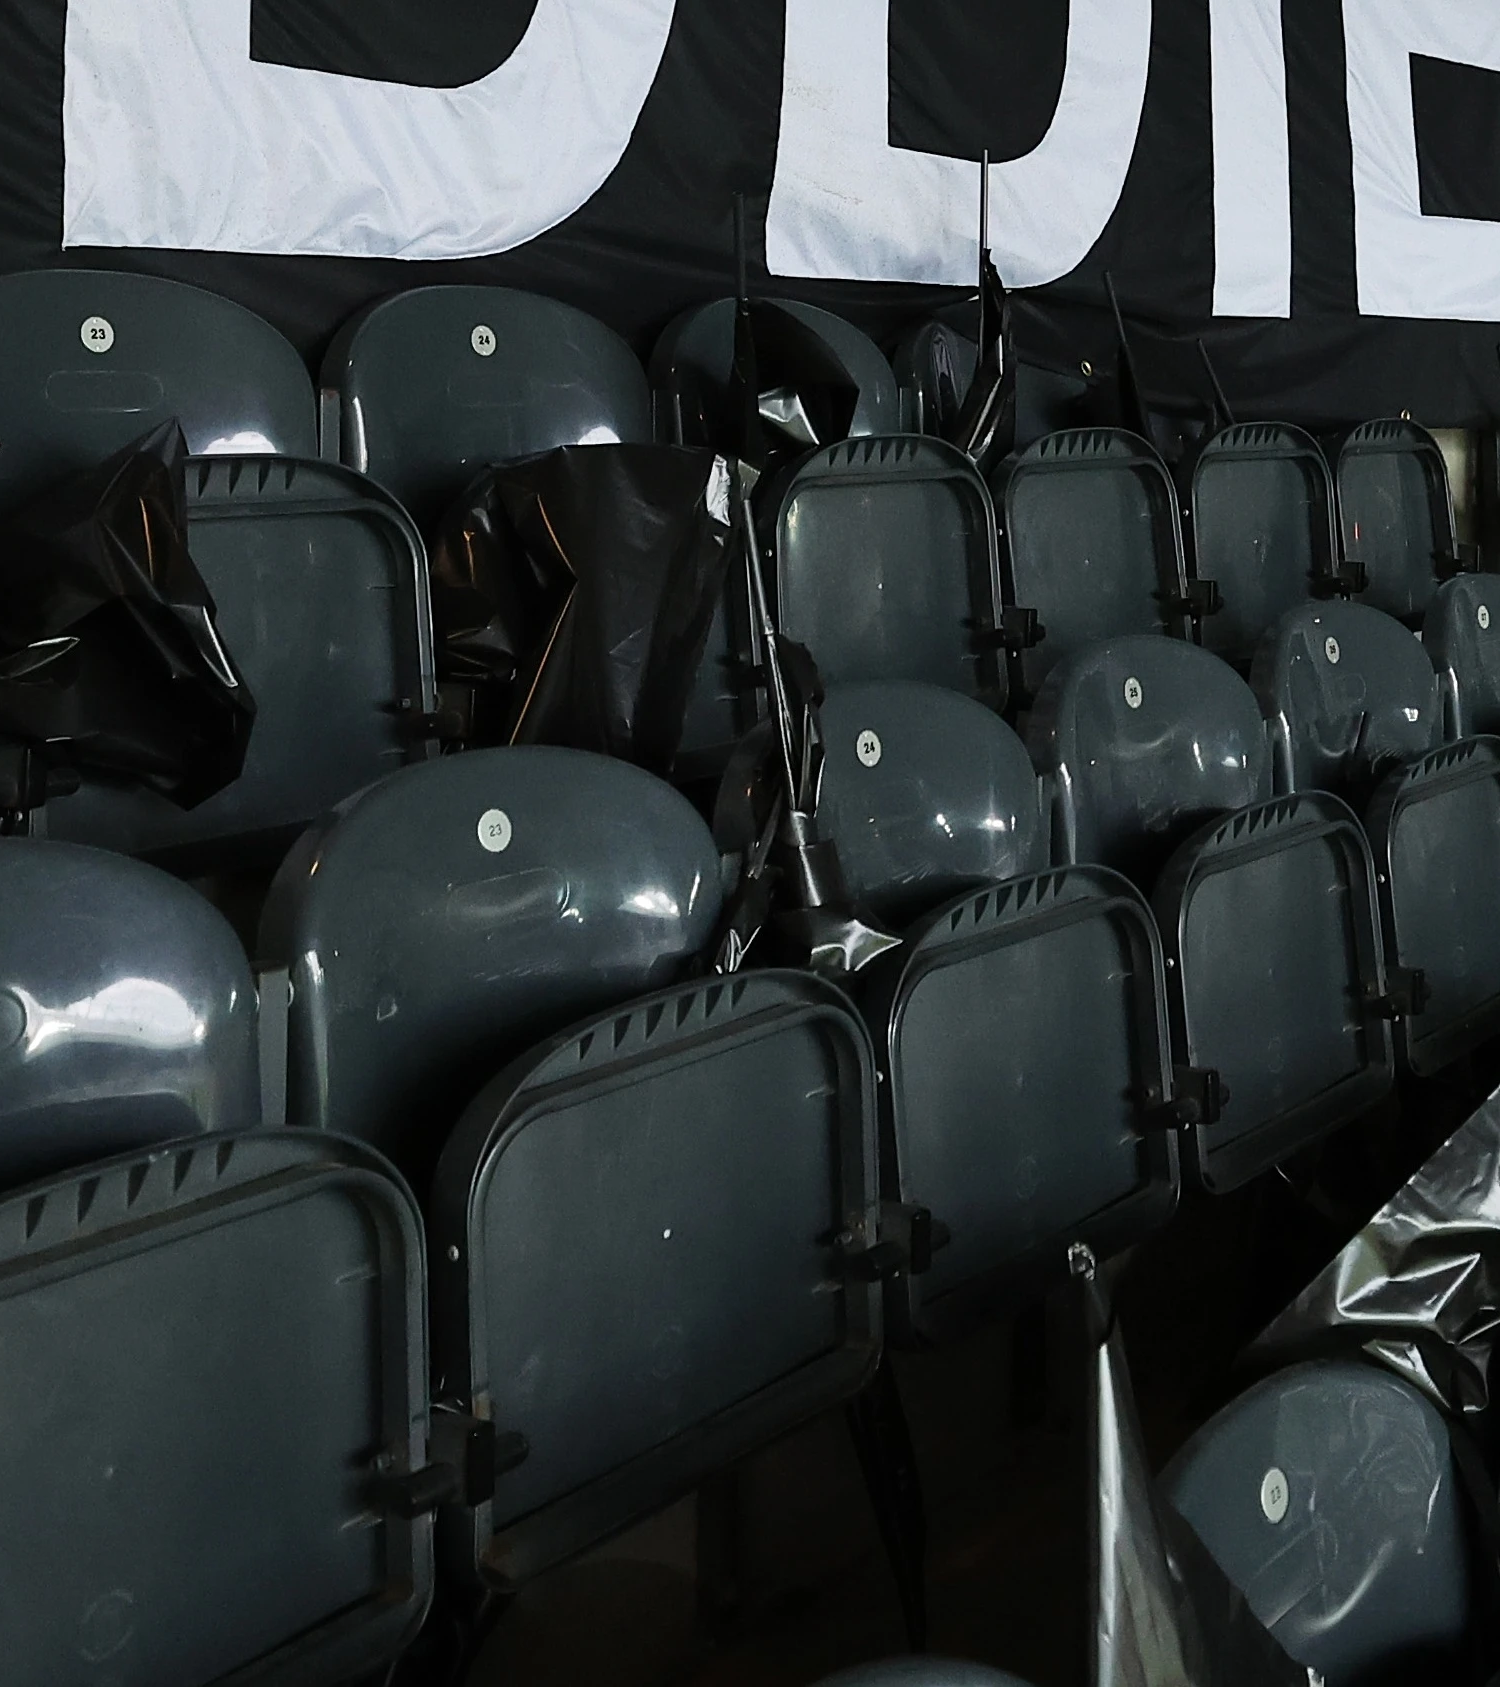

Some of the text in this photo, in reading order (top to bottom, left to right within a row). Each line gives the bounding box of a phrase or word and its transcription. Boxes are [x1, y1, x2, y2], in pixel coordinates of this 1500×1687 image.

[90, 328, 106, 340] 23
[478, 334, 490, 345] 24
[1129, 687, 1138, 697] 25
[864, 742, 875, 754] 24
[489, 823, 502, 837] 23
